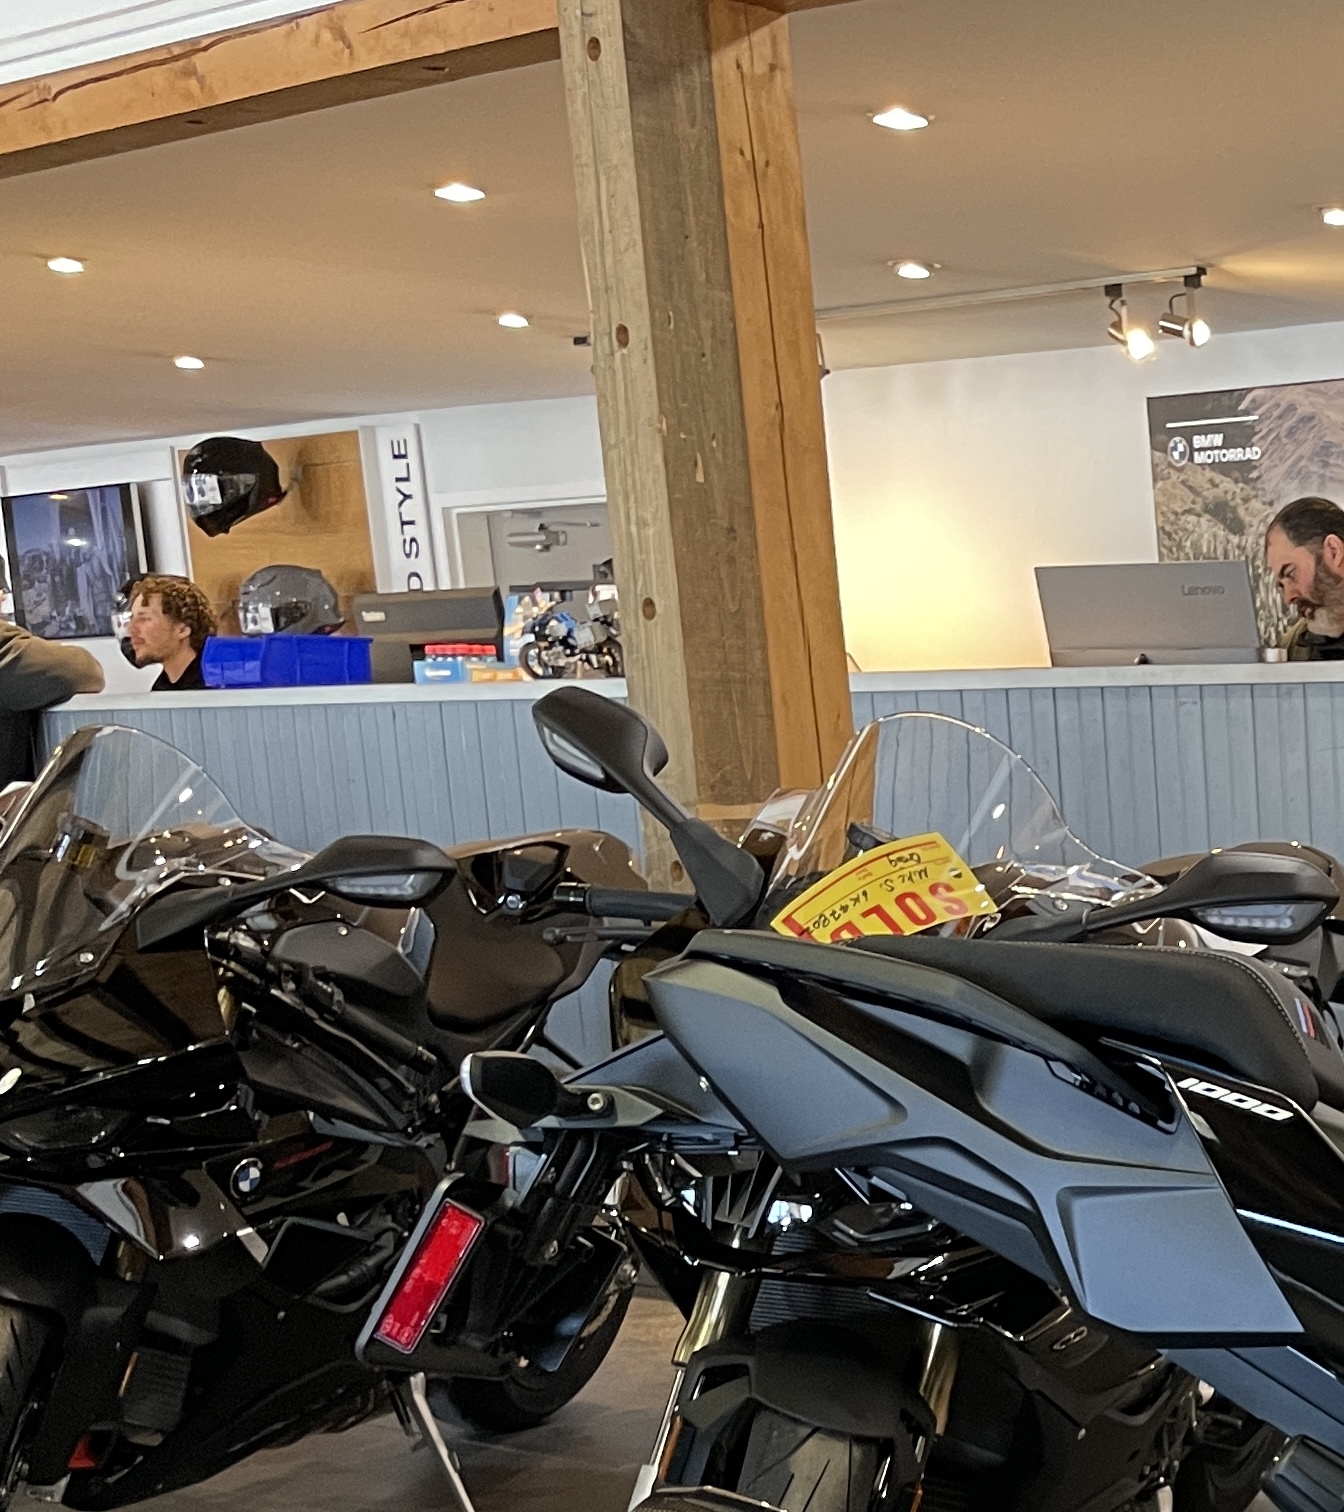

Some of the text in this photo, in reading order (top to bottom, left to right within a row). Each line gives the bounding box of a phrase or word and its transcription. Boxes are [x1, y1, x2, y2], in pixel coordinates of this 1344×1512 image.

[1192, 433, 1224, 448] BMW
[1193, 446, 1262, 464] MOTORRAD
[390, 437, 420, 560] STYLE
[1181, 583, 1226, 598] Lenovo
[1177, 1077, 1294, 1121] 1000
